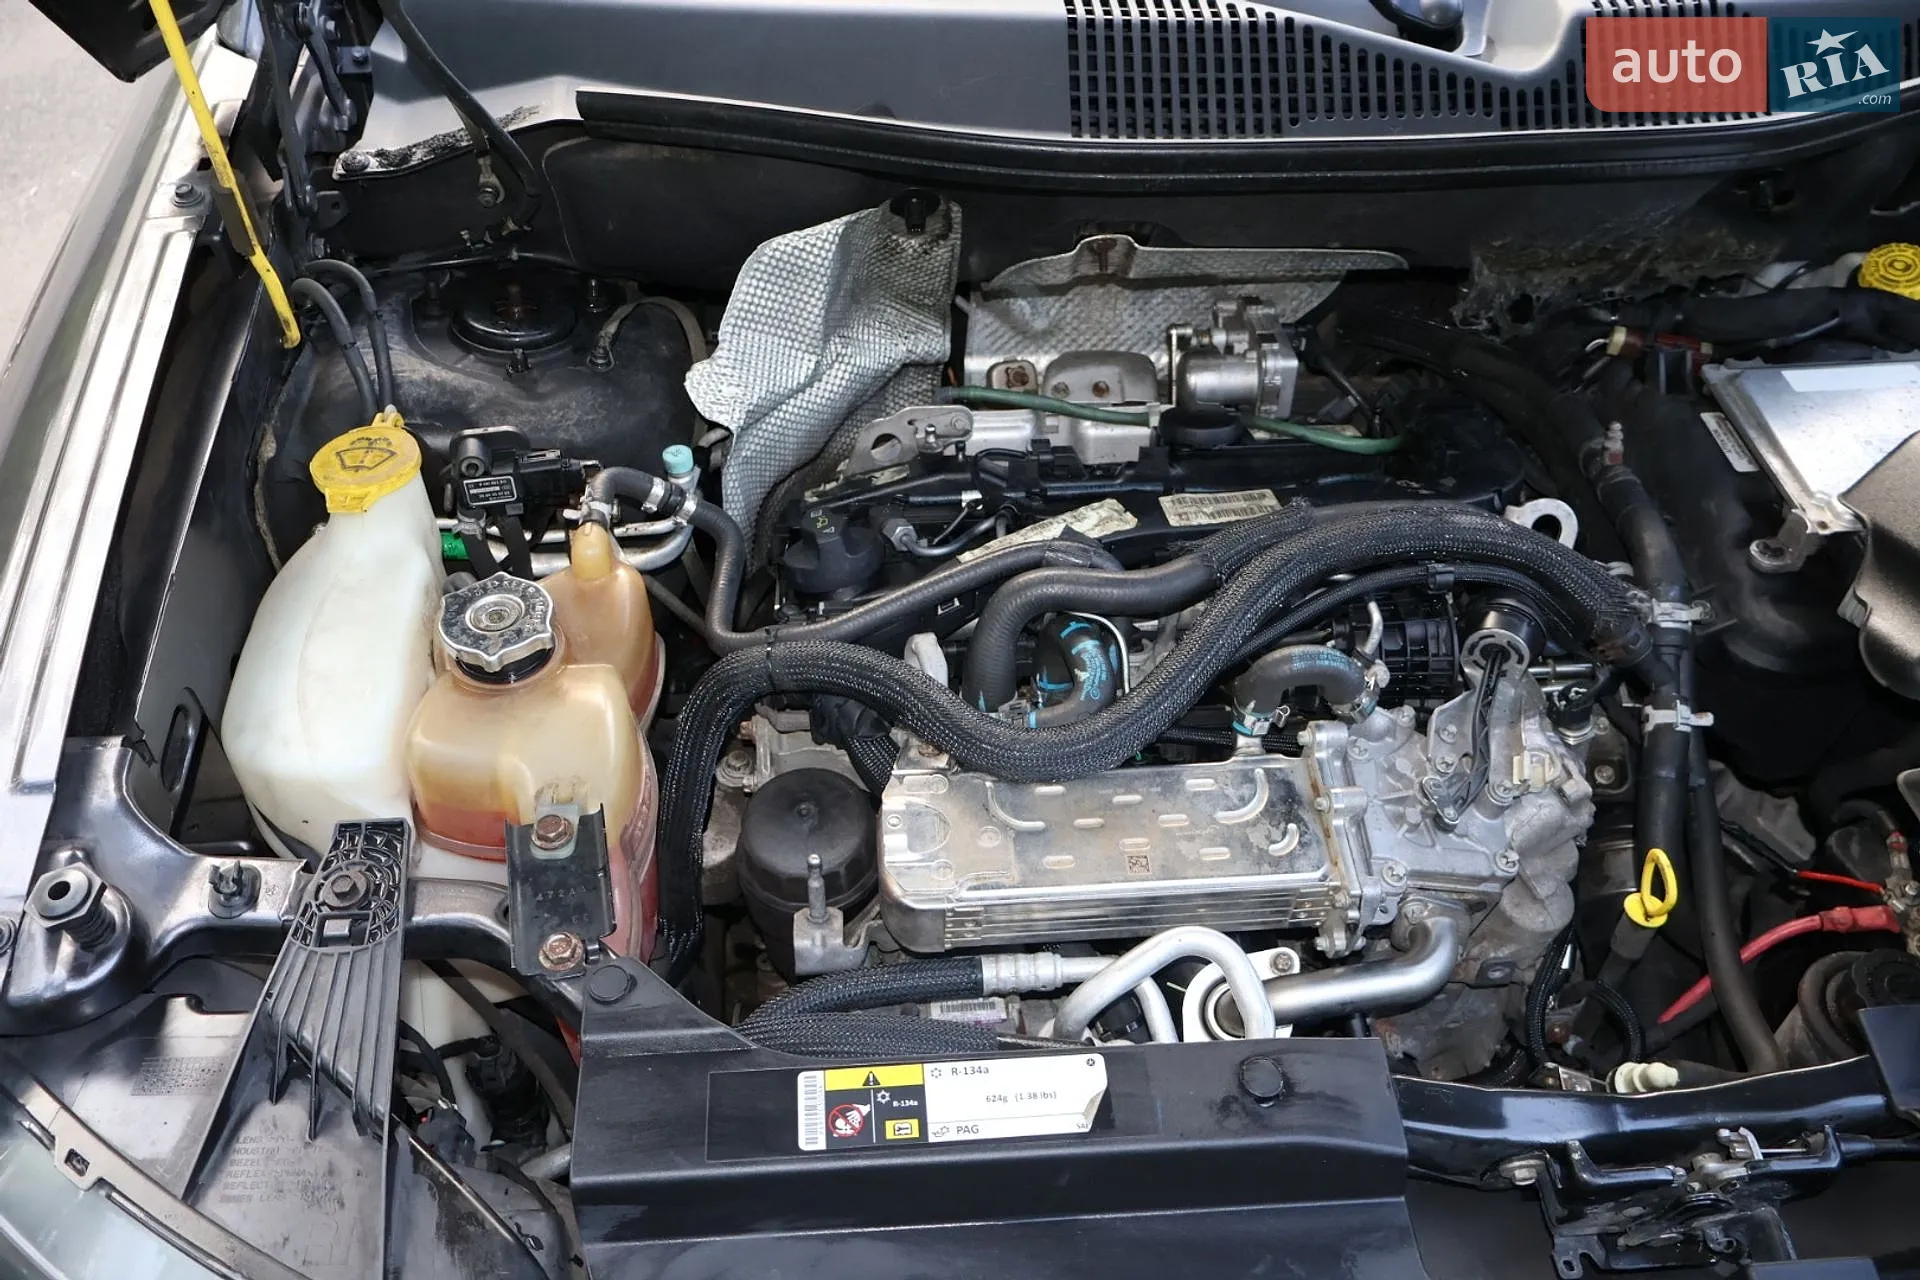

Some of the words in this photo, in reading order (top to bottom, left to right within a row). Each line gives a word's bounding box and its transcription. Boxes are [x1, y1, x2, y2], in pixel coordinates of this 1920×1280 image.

[951, 1066, 990, 1076] R-134a
[986, 1094, 1009, 1104] 624g
[1040, 1090, 1057, 1100] lbs)
[892, 1099, 918, 1108] R-134a
[956, 1124, 979, 1134] PAG
